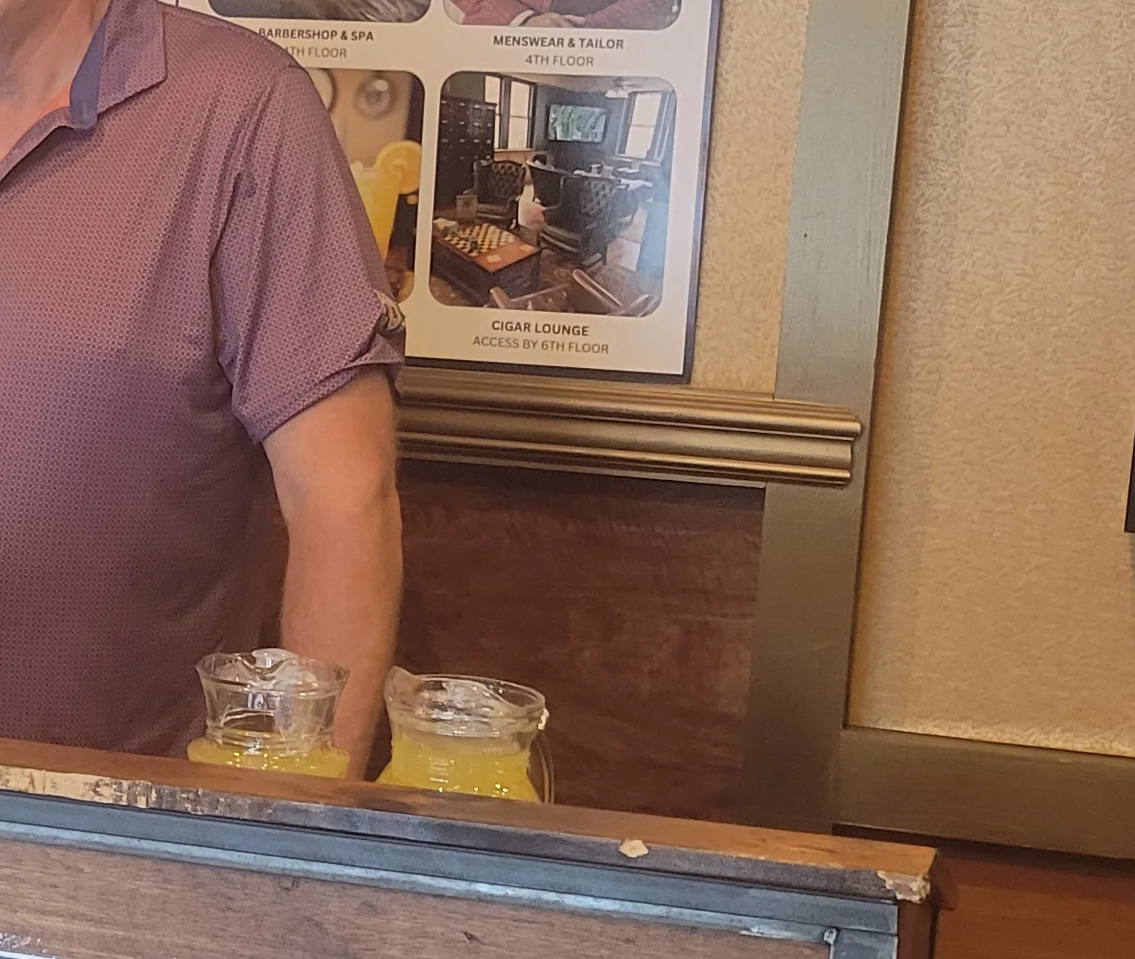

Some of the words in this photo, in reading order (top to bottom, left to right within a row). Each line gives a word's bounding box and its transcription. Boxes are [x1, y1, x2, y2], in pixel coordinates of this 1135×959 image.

[258, 28, 338, 40] BARBERSHOP
[340, 30, 348, 41] &
[351, 31, 374, 41] SPA
[493, 35, 565, 48] MENSWEAR
[567, 37, 576, 48] &
[579, 37, 624, 50] TAILOR
[285, 46, 304, 57] TH
[308, 47, 347, 58] FLOOR
[525, 54, 549, 65] 4TH
[552, 55, 594, 67] FLOOR
[491, 320, 531, 333] CIGAR
[534, 323, 590, 337] LOUNGE
[472, 336, 520, 349] ACCESS
[522, 339, 539, 350] BY
[541, 340, 564, 352] 6TH
[568, 342, 609, 354] FLOOR
